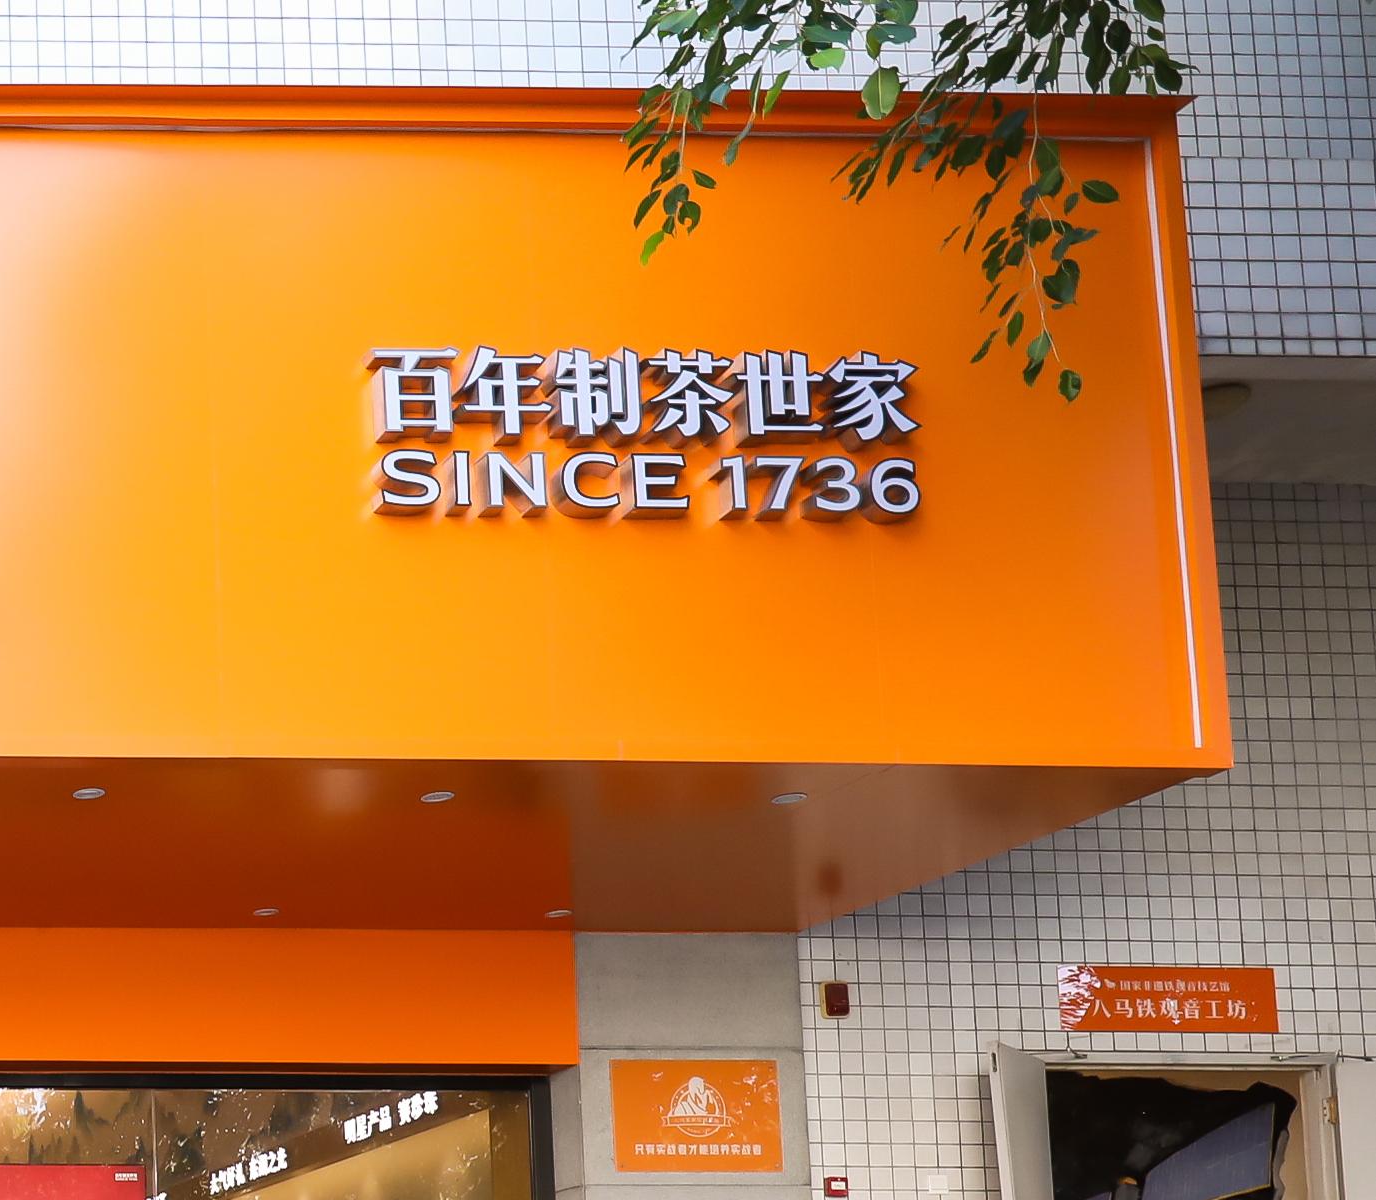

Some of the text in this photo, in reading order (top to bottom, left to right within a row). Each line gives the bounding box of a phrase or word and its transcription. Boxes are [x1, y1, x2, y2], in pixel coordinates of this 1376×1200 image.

[369, 346, 921, 443] 百年制茶世家
[377, 450, 921, 516] SINCE 1736
[1092, 997, 1248, 1020] 八马铁观音工坊
